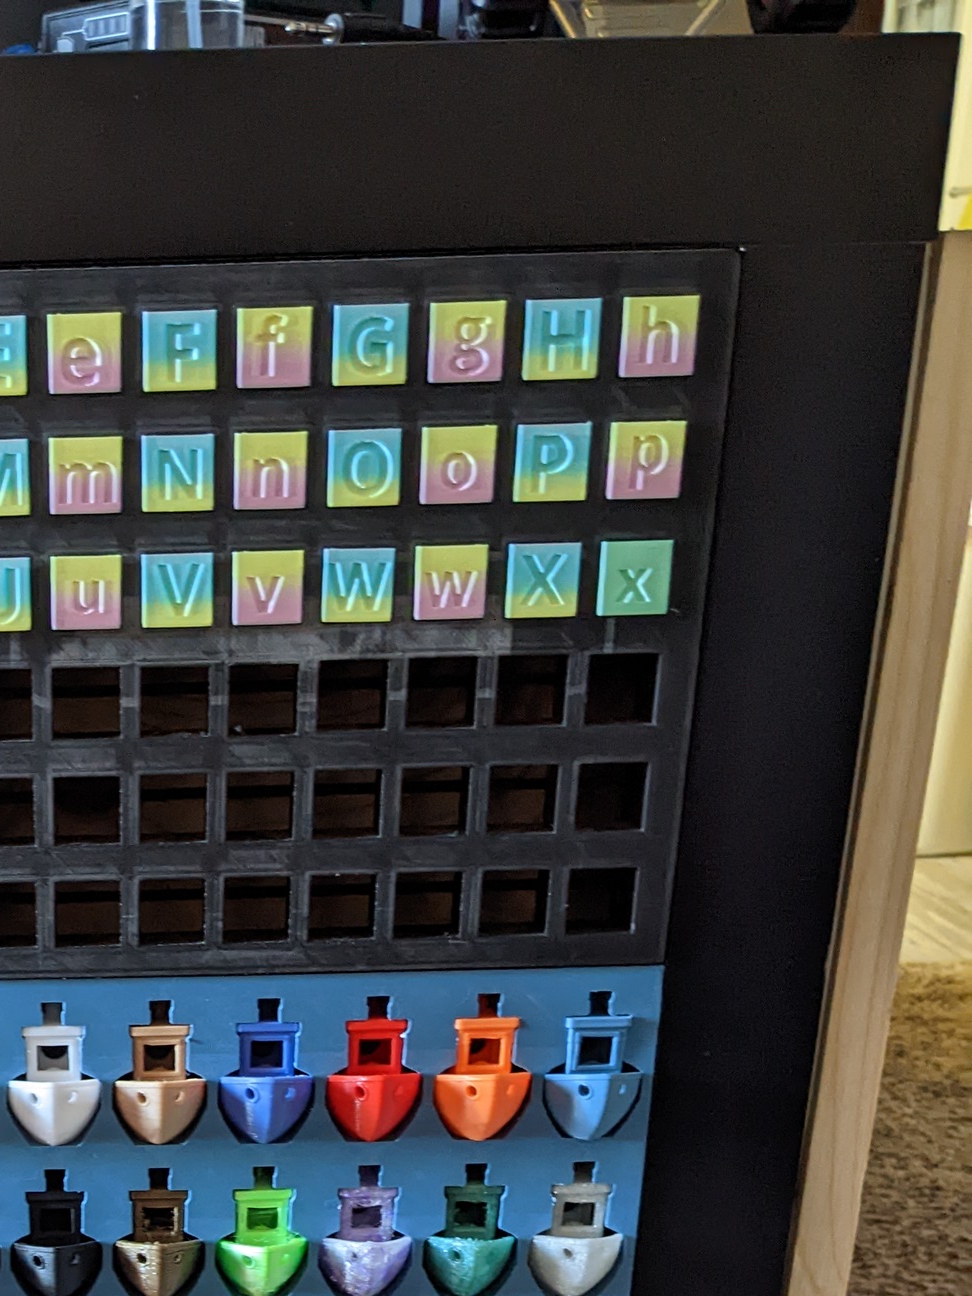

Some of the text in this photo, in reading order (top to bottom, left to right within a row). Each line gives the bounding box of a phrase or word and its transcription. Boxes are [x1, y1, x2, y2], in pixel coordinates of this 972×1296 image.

[61, 337, 102, 386] e
[166, 322, 200, 382] F
[255, 313, 289, 377] f
[348, 316, 395, 376] G
[449, 317, 492, 376] g
[542, 309, 592, 371] H
[636, 304, 679, 364] h
[58, 461, 118, 504] m
[157, 449, 203, 500] N
[252, 457, 289, 498] n
[342, 440, 395, 498] O
[533, 432, 574, 494] P
[629, 433, 669, 490] p
[73, 580, 105, 615] u
[156, 562, 205, 617] V
[329, 561, 392, 611] W
[522, 554, 568, 606] X
